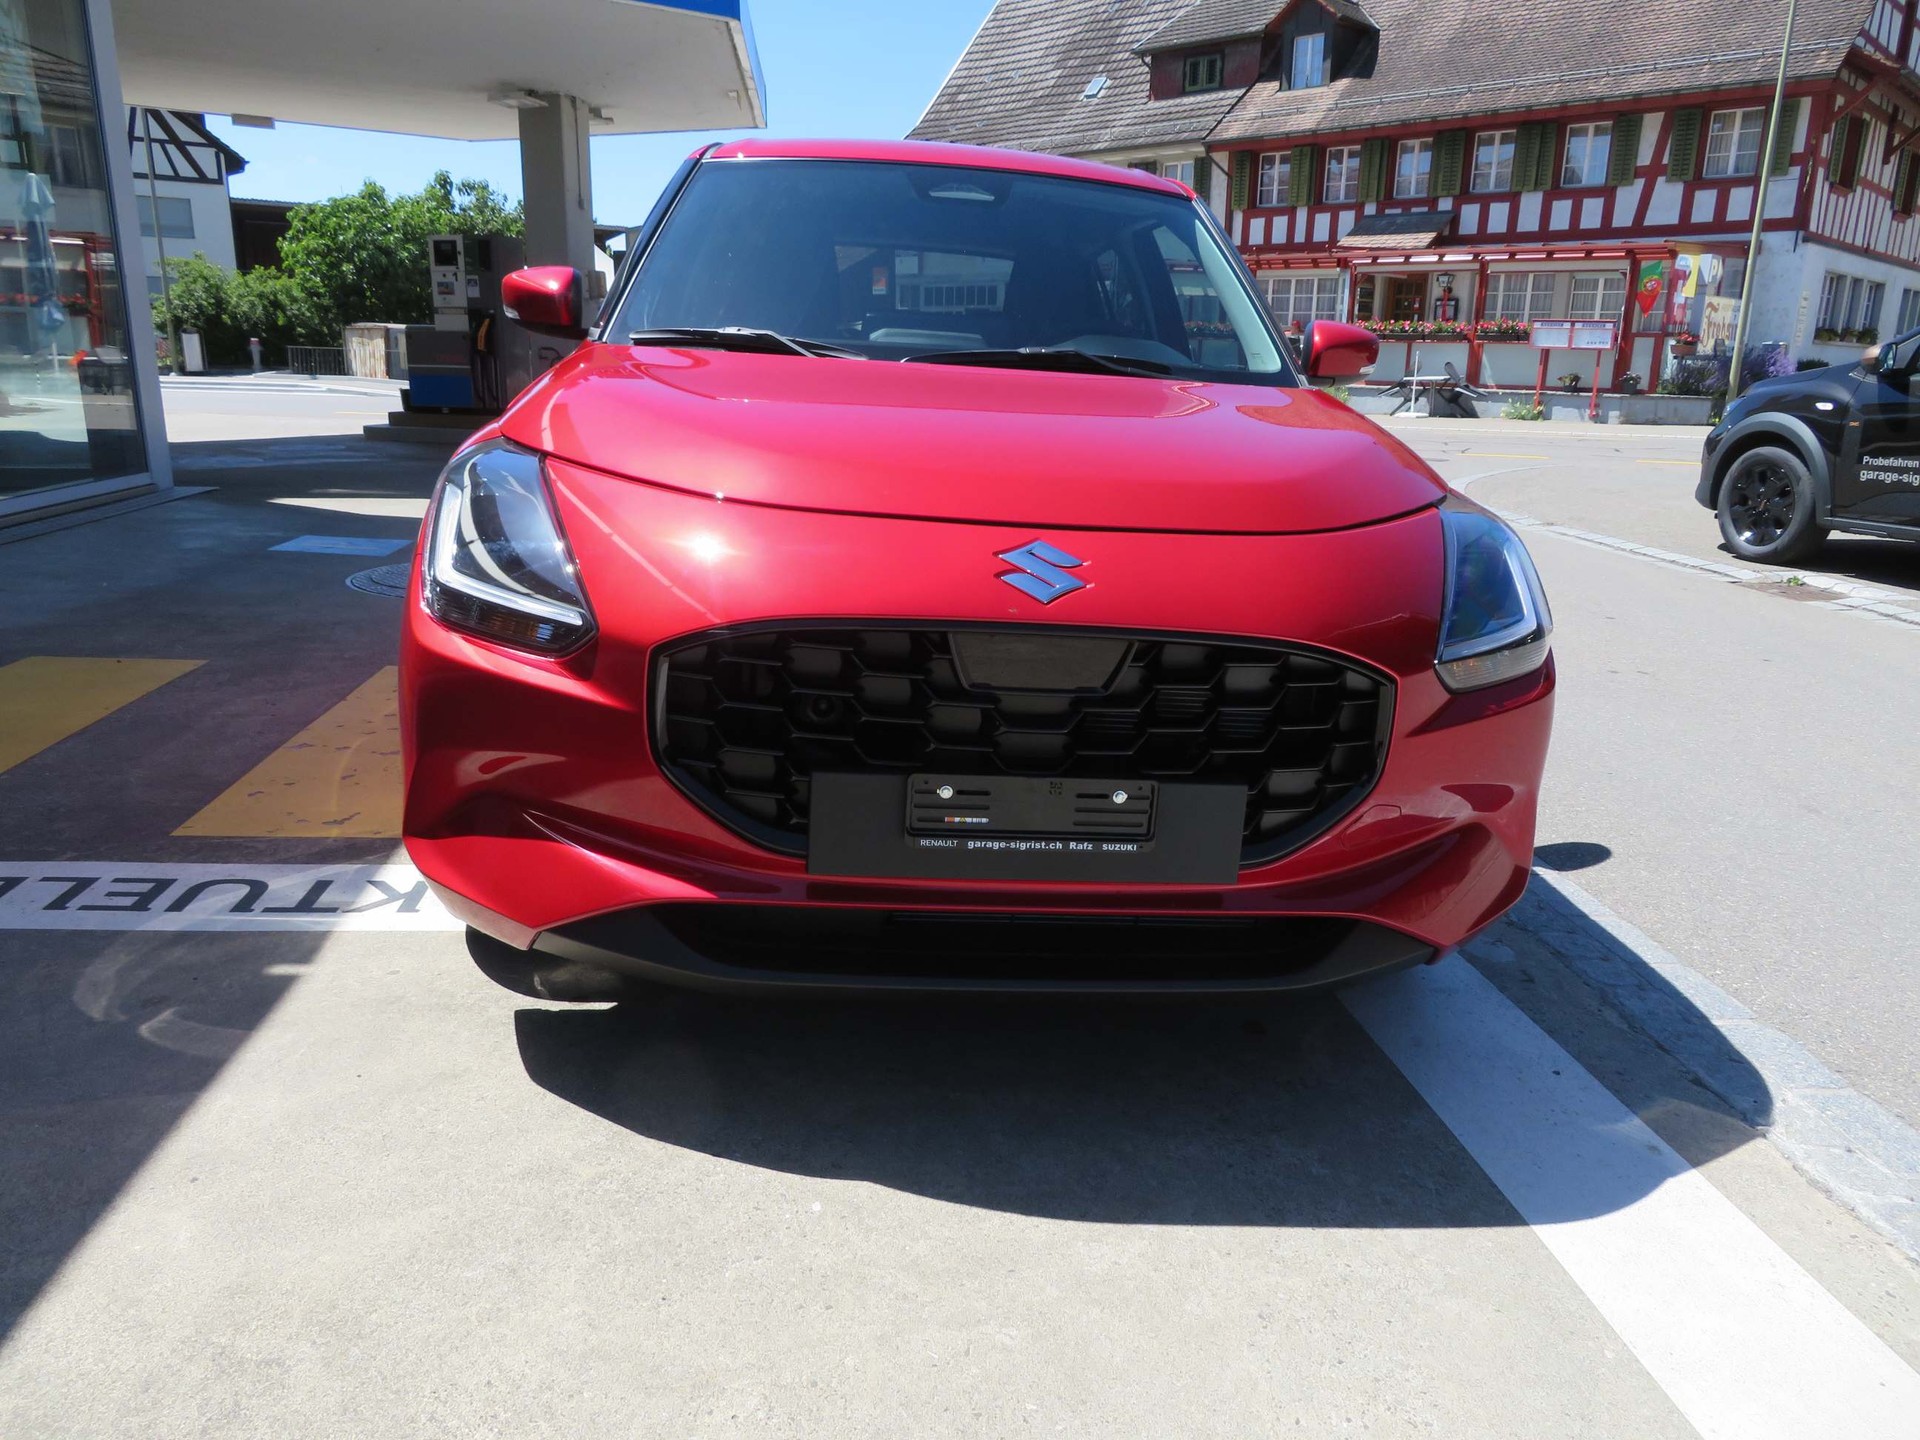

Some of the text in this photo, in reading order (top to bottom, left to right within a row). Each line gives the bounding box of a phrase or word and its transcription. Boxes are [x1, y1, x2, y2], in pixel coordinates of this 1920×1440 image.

[1862, 455, 1919, 468] Probefahren
[1859, 470, 1920, 486] garage-sig
[920, 839, 1137, 851] RENAULT garage-sigrist.ch Rafz SUZUKI
